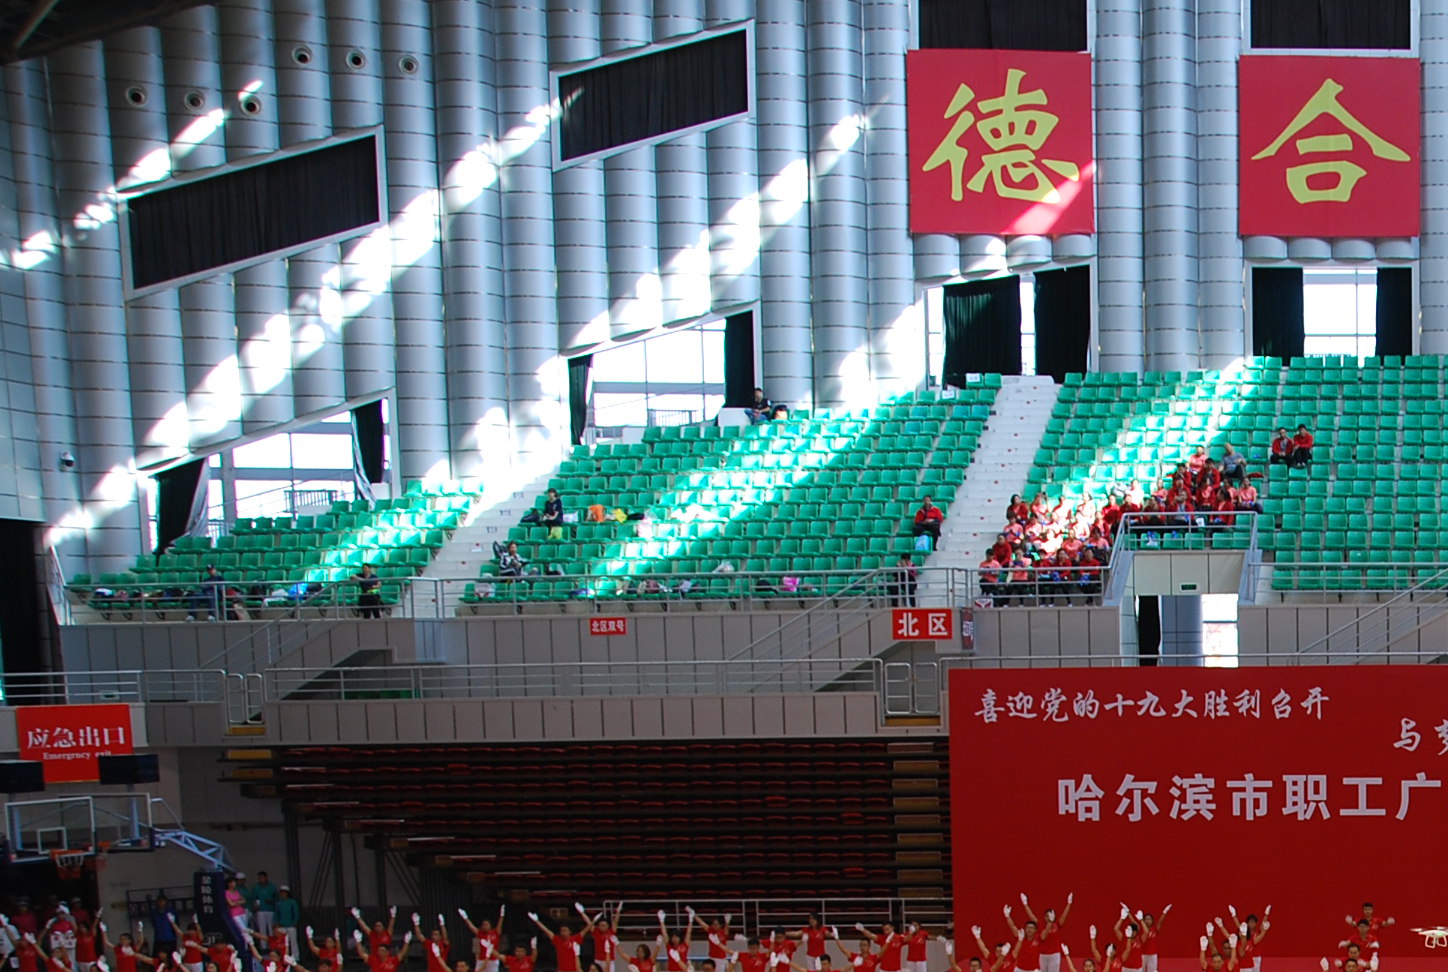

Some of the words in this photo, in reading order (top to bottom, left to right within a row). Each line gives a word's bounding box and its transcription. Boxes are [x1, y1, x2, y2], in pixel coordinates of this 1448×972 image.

[922, 68, 1080, 204] 德
[1251, 78, 1412, 205] 合
[898, 612, 949, 637] 北区
[974, 687, 1331, 725] 喜迎党的十九大胜利召开
[28, 726, 125, 749] 应急出口
